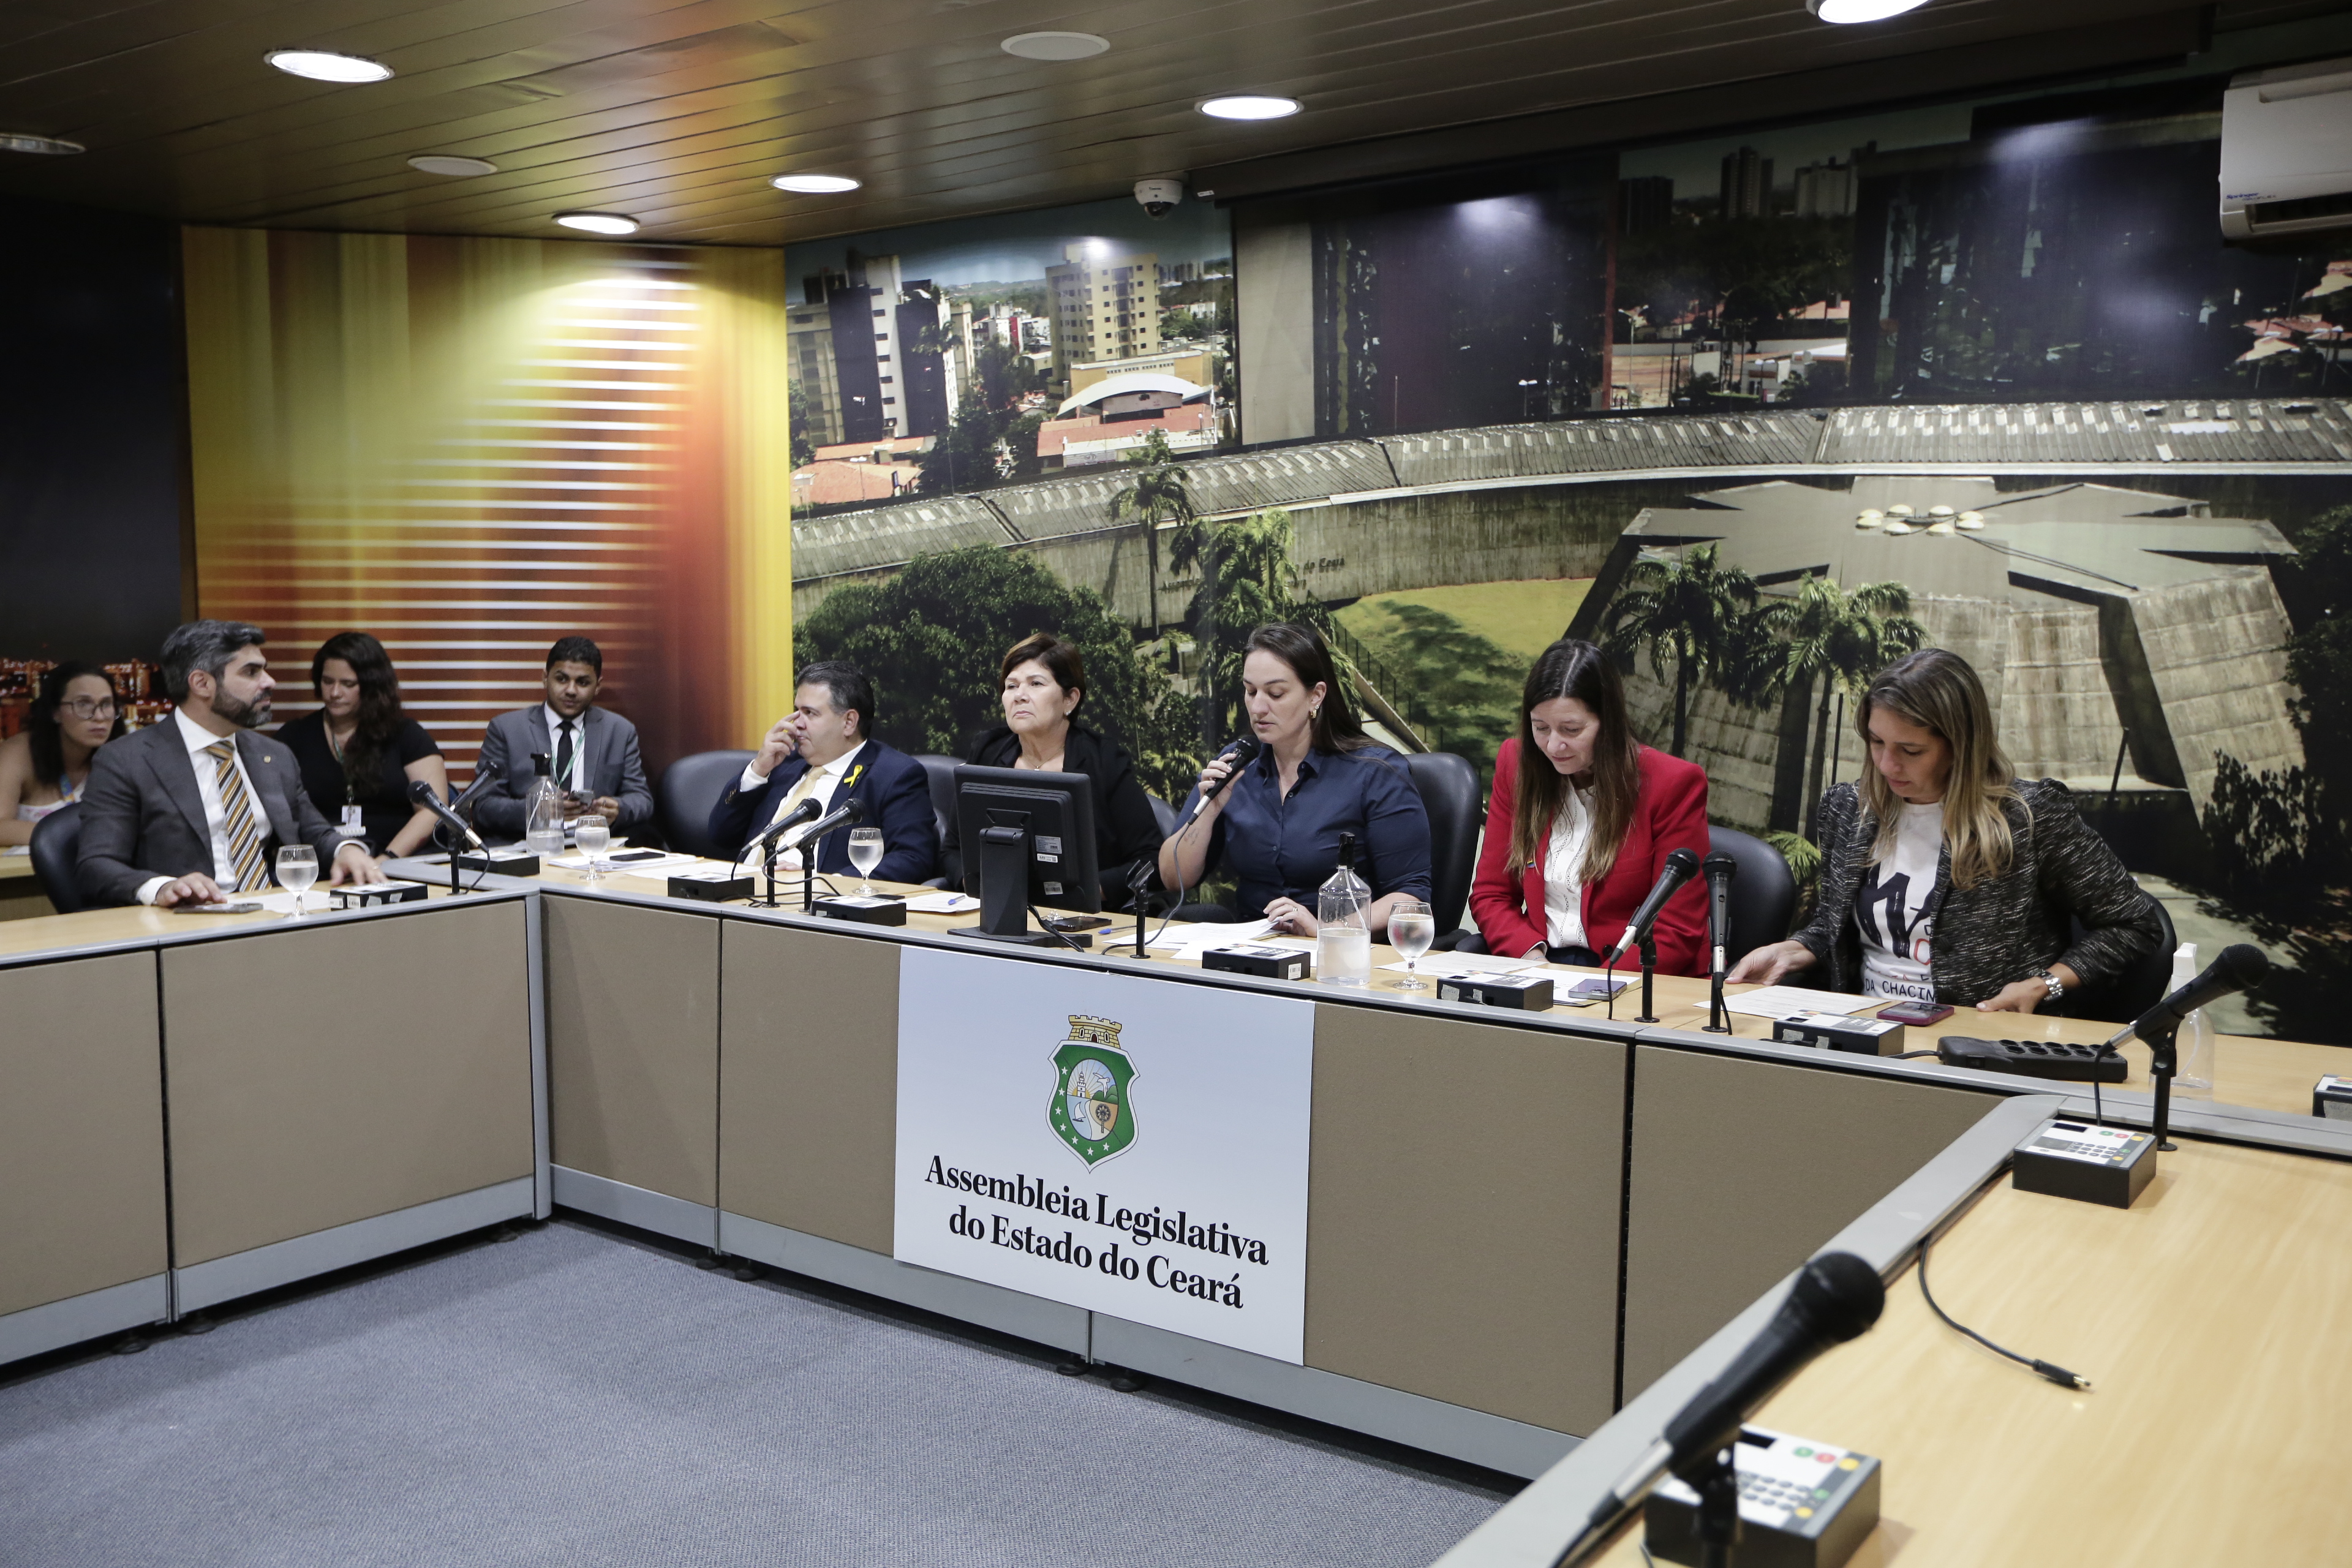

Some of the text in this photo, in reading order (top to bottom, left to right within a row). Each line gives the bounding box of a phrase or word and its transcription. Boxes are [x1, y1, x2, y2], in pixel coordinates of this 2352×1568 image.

[1866, 979, 1875, 992] DA
[925, 1155, 1269, 1265] Assembleia Legislativa
[949, 1204, 1244, 1309] do Estado do Ceará
